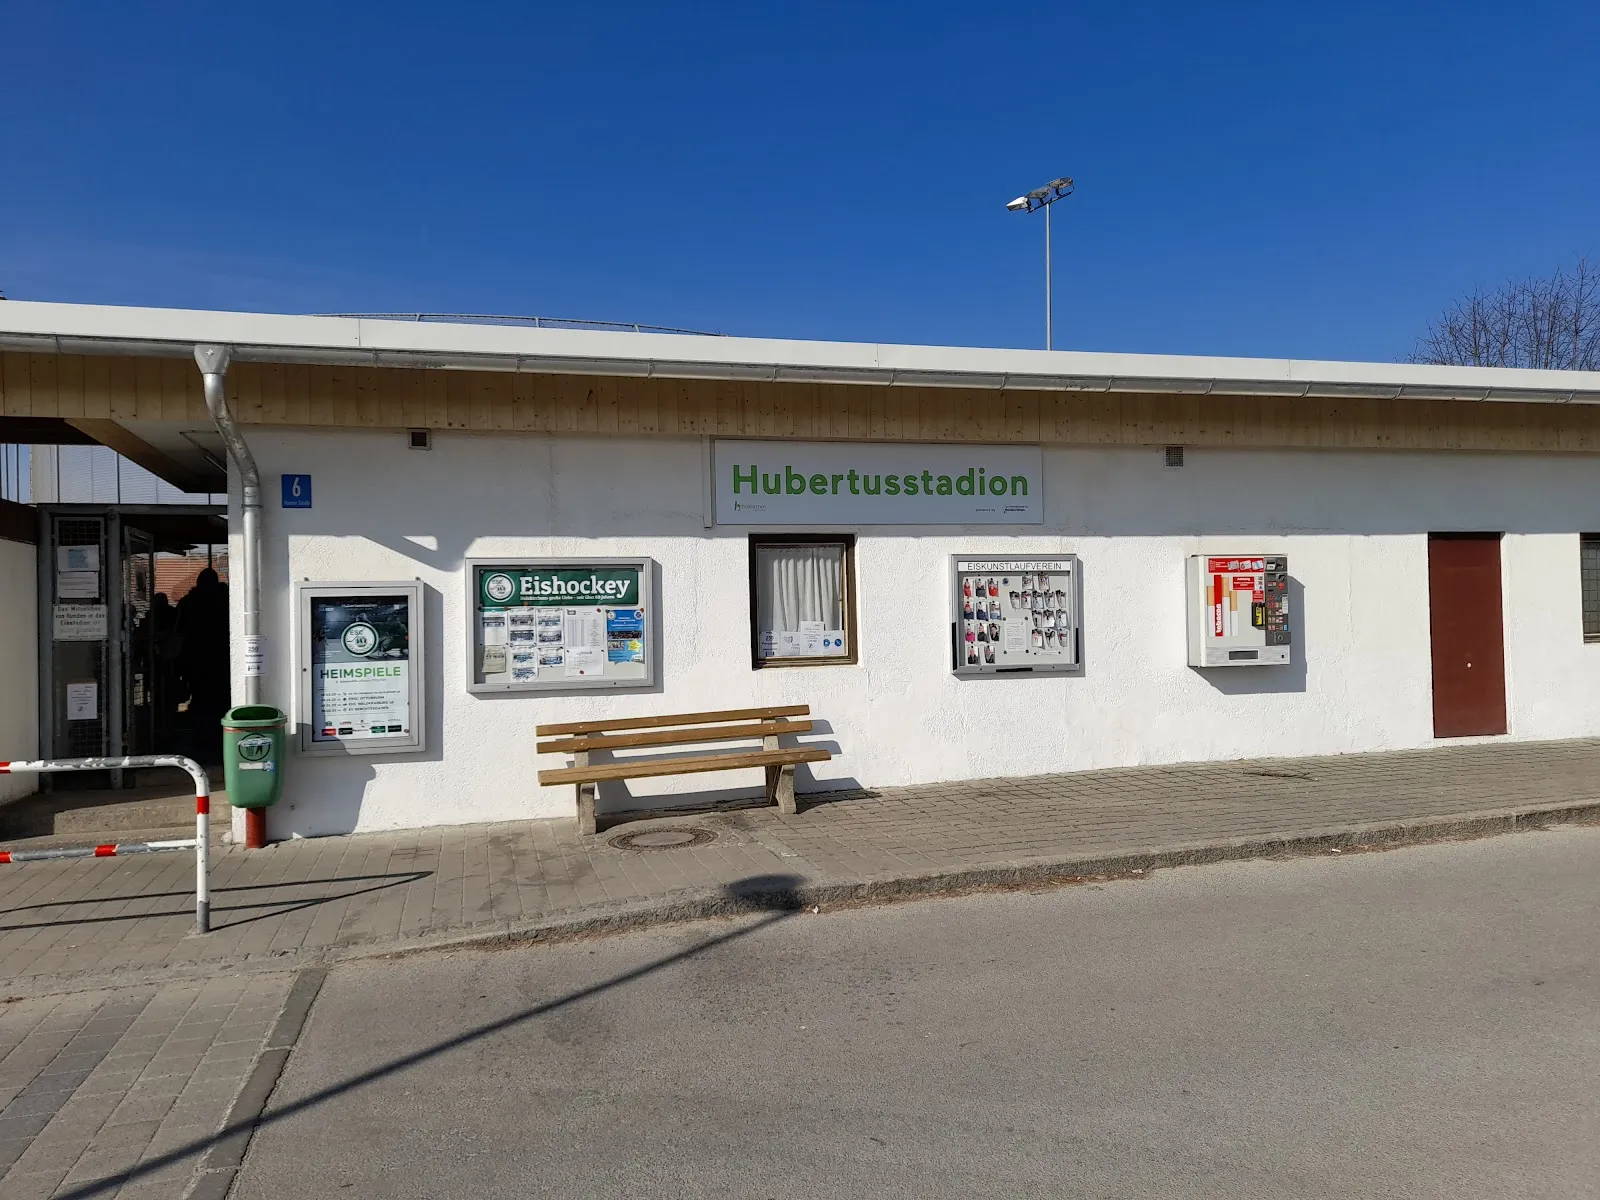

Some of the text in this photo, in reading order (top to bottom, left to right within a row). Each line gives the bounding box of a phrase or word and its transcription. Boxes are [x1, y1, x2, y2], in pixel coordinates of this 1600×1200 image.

[292, 477, 301, 497] 6
[733, 464, 1028, 496] Hubertusstadion
[967, 563, 1062, 571] EISKUNSTLAUFVEREIN
[519, 575, 631, 599] Eishockey
[320, 666, 402, 679] HEIMSPIELE
